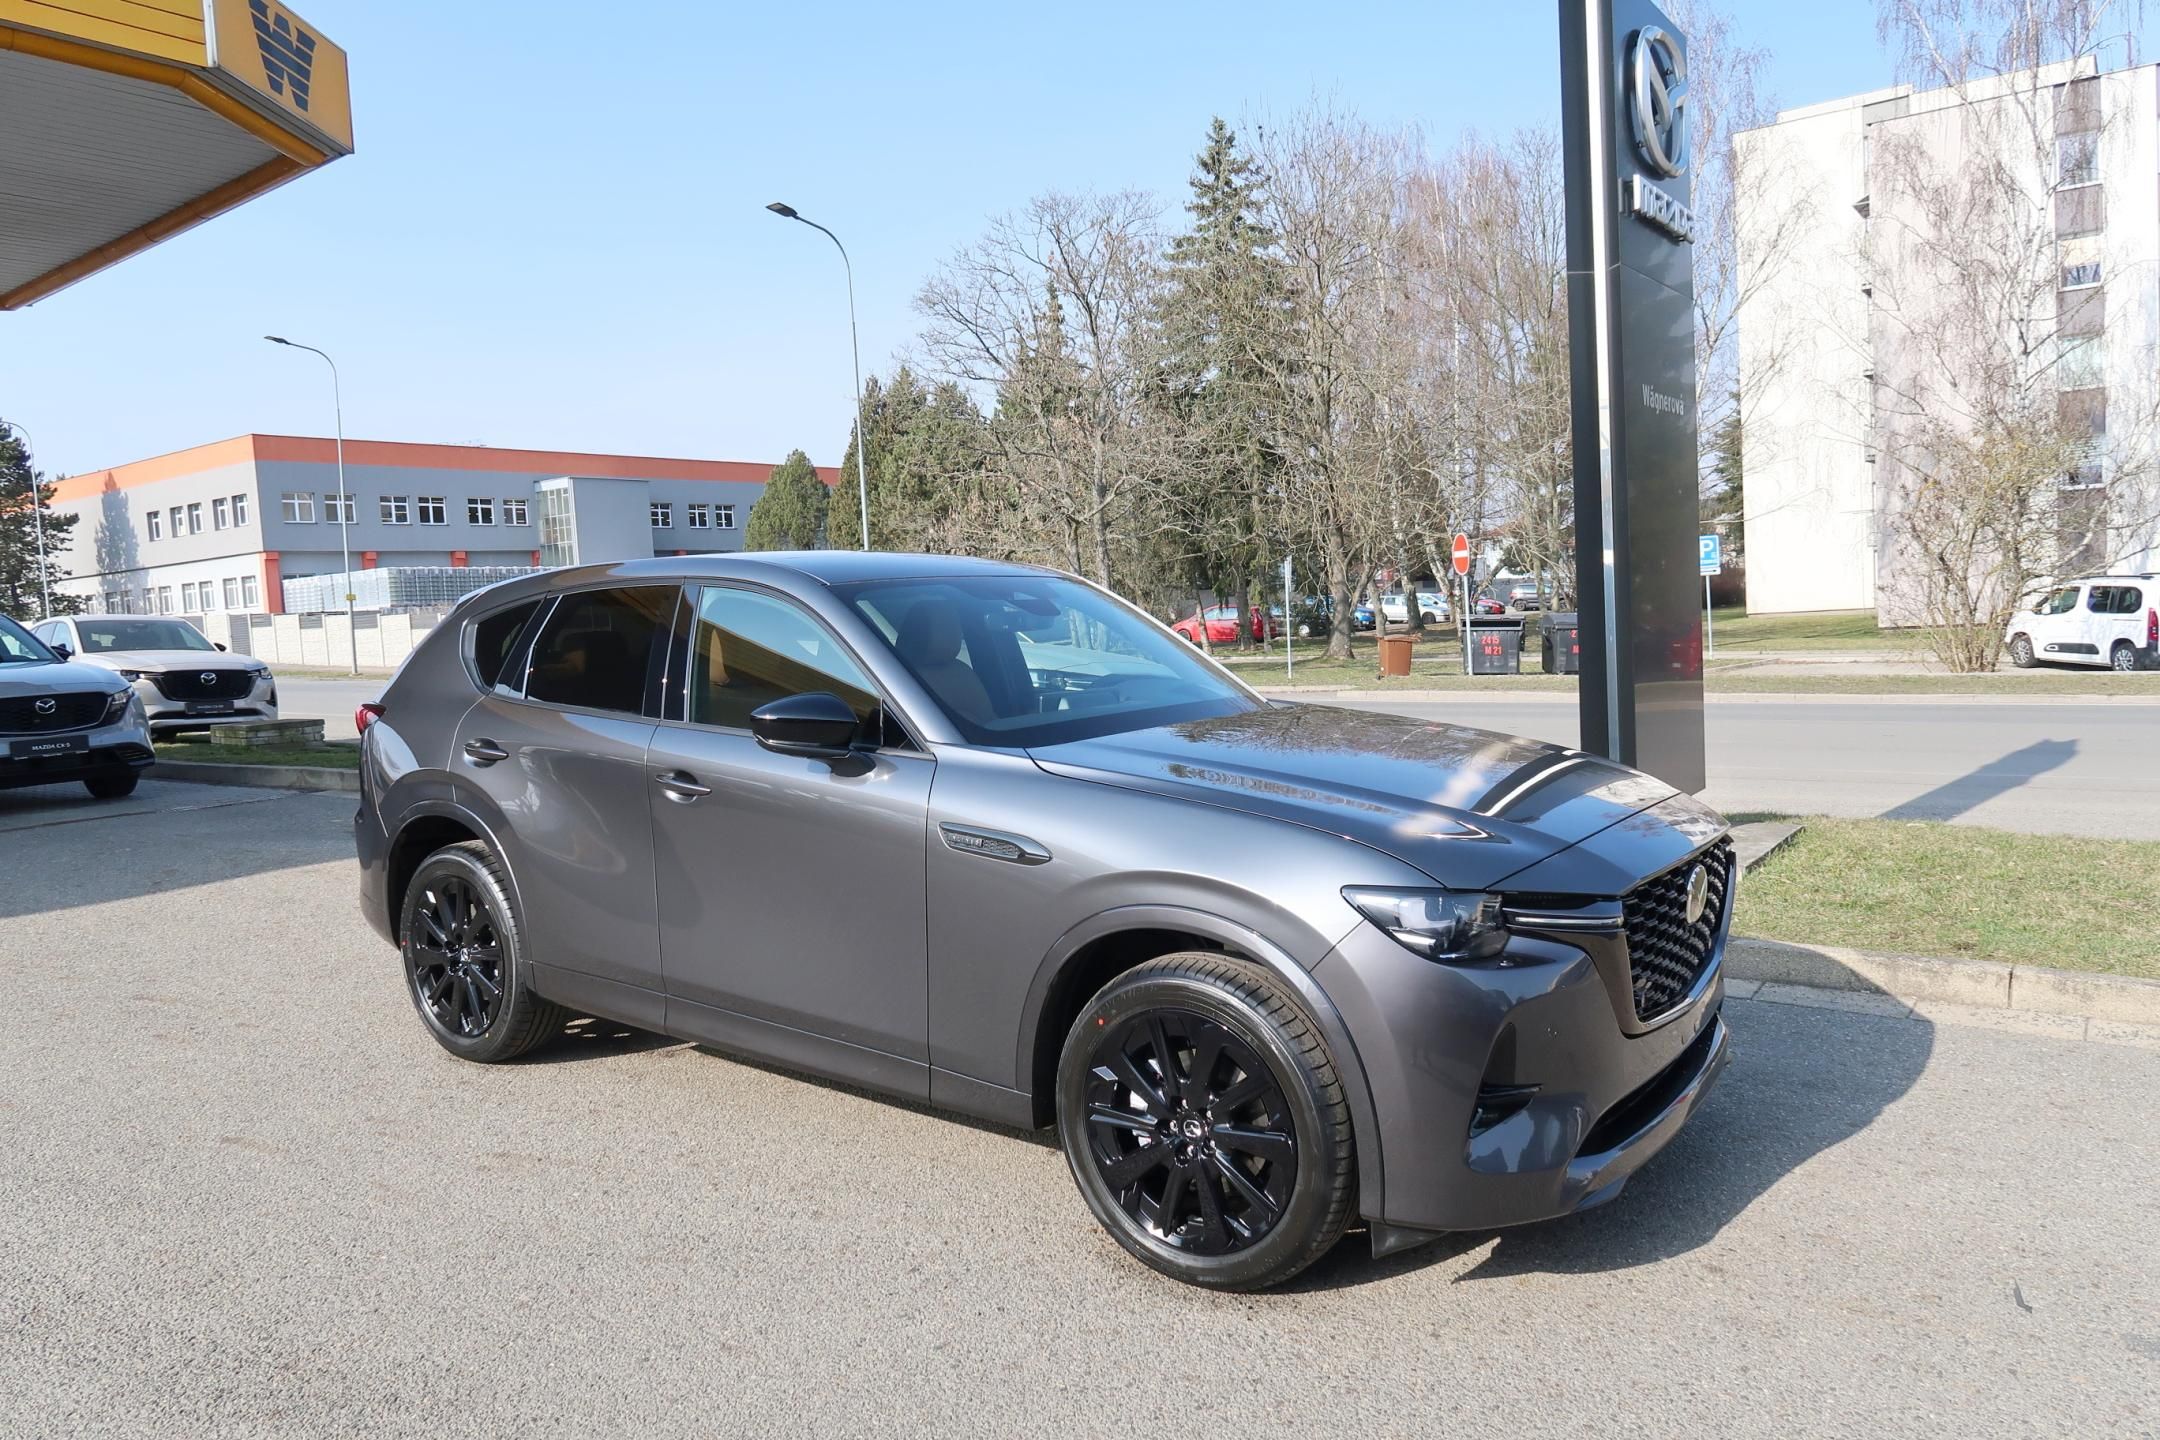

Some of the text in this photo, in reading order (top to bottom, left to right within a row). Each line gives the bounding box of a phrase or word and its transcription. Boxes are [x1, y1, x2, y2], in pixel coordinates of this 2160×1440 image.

[1642, 384, 1684, 415] Wágnerová
[1700, 540, 1714, 558] P
[1481, 636, 1500, 645] 2415
[1484, 646, 1502, 655] M 21
